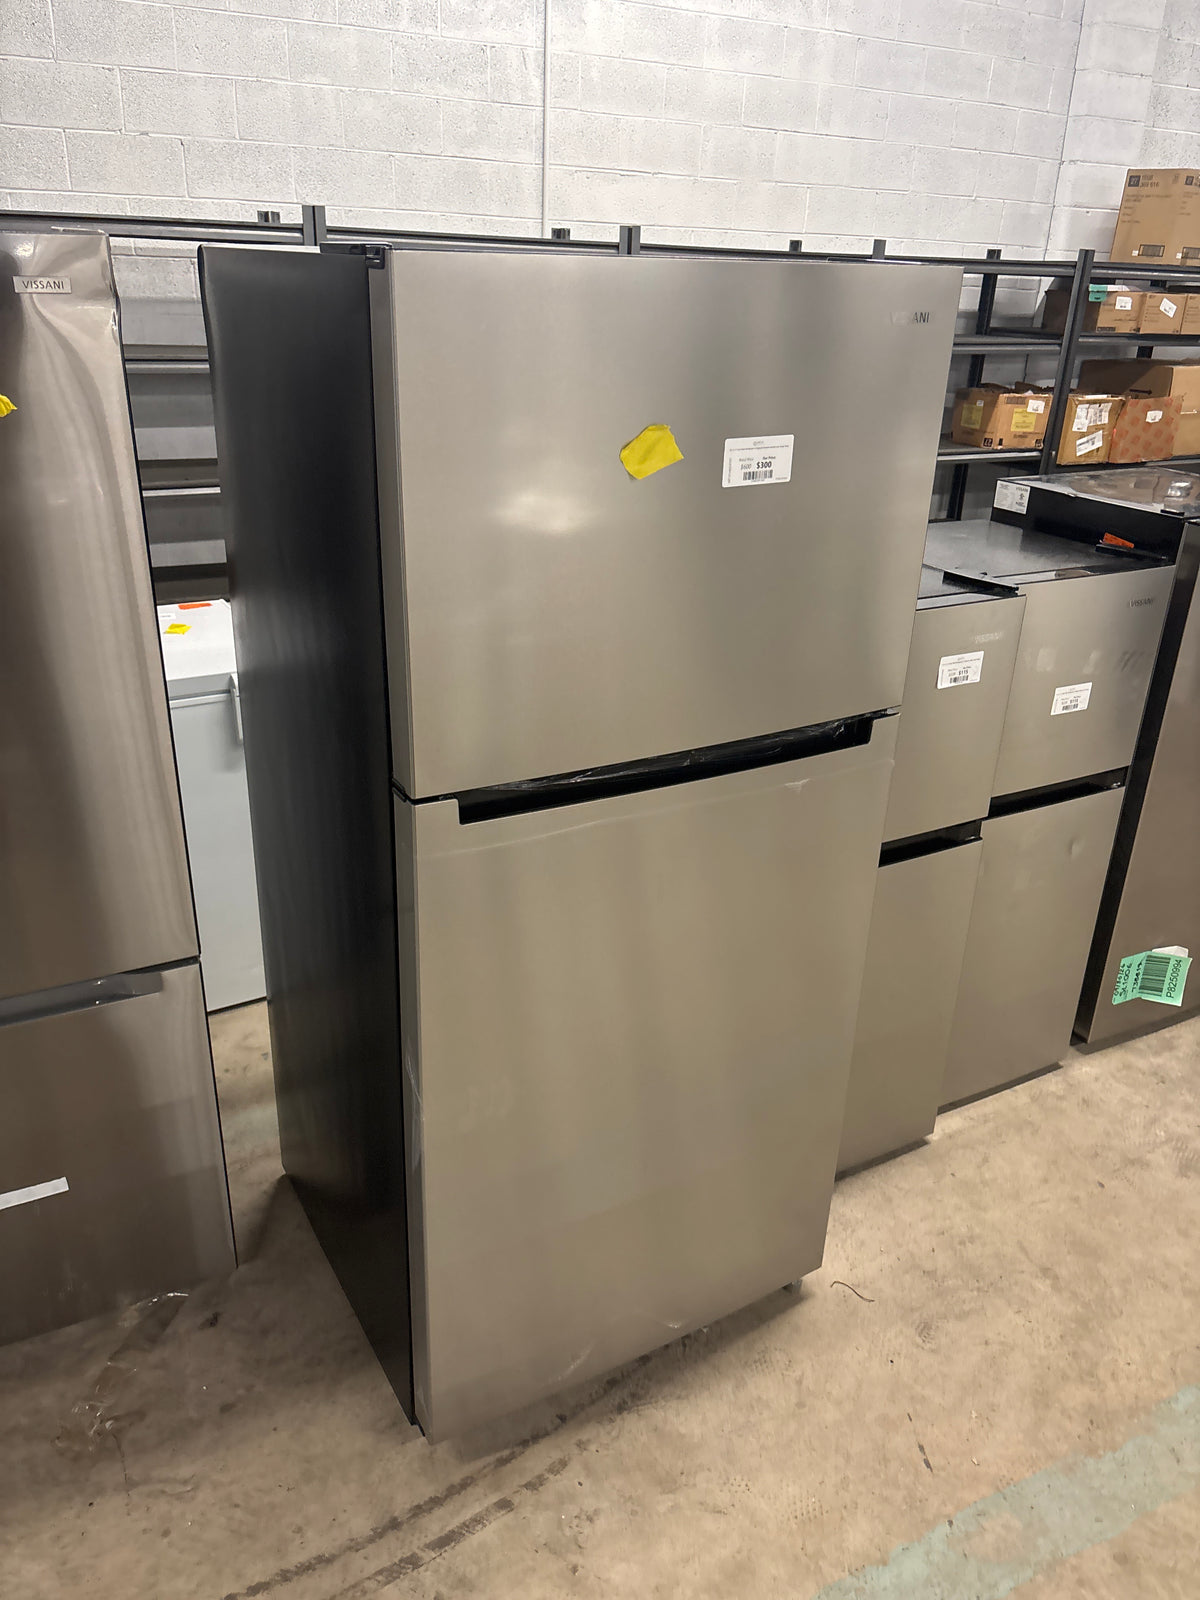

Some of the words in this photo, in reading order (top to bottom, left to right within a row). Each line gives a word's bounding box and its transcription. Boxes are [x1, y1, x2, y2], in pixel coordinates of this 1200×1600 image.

[22, 280, 65, 290] VISSANI
[756, 461, 772, 469] $300
[1165, 959, 1182, 999] P8250994
